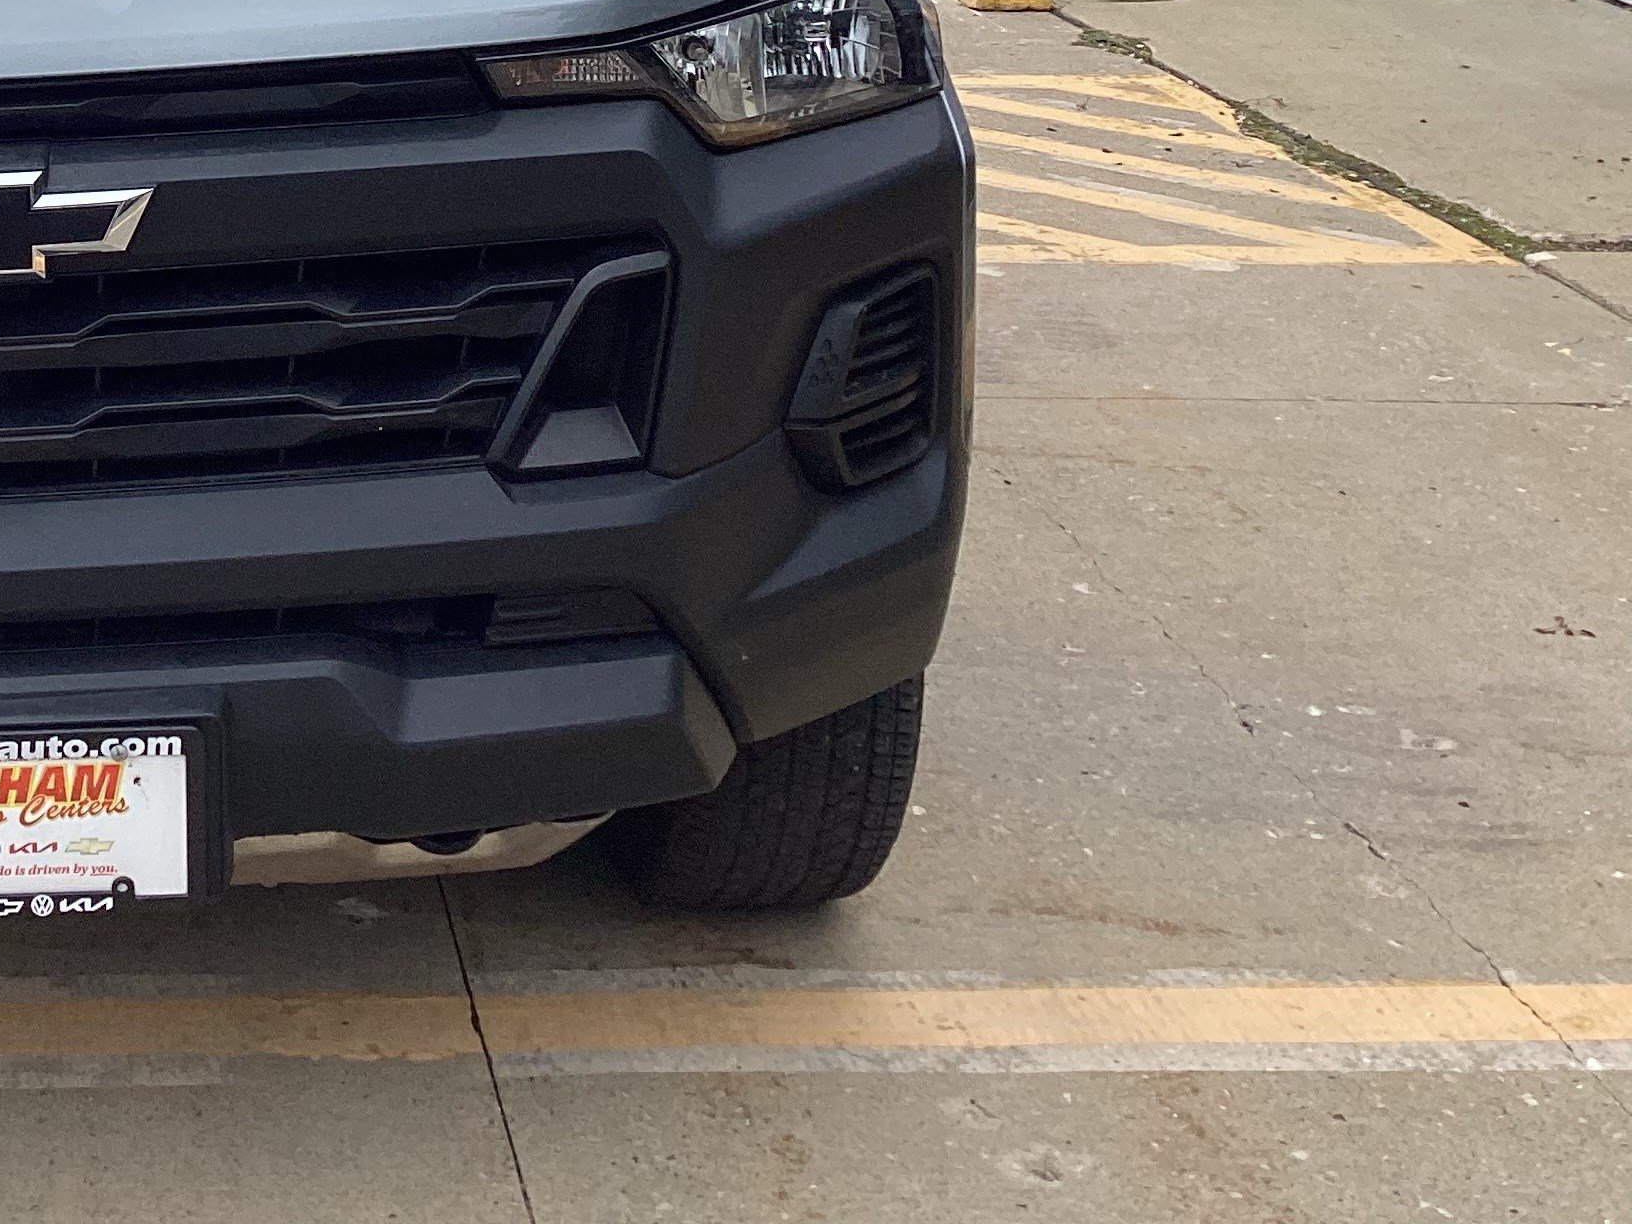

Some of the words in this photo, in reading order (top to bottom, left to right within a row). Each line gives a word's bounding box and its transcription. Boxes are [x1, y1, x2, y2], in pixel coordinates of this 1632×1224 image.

[19, 793, 129, 827] Centers
[16, 865, 26, 876] is
[28, 863, 69, 875] driven
[73, 863, 88, 878] by
